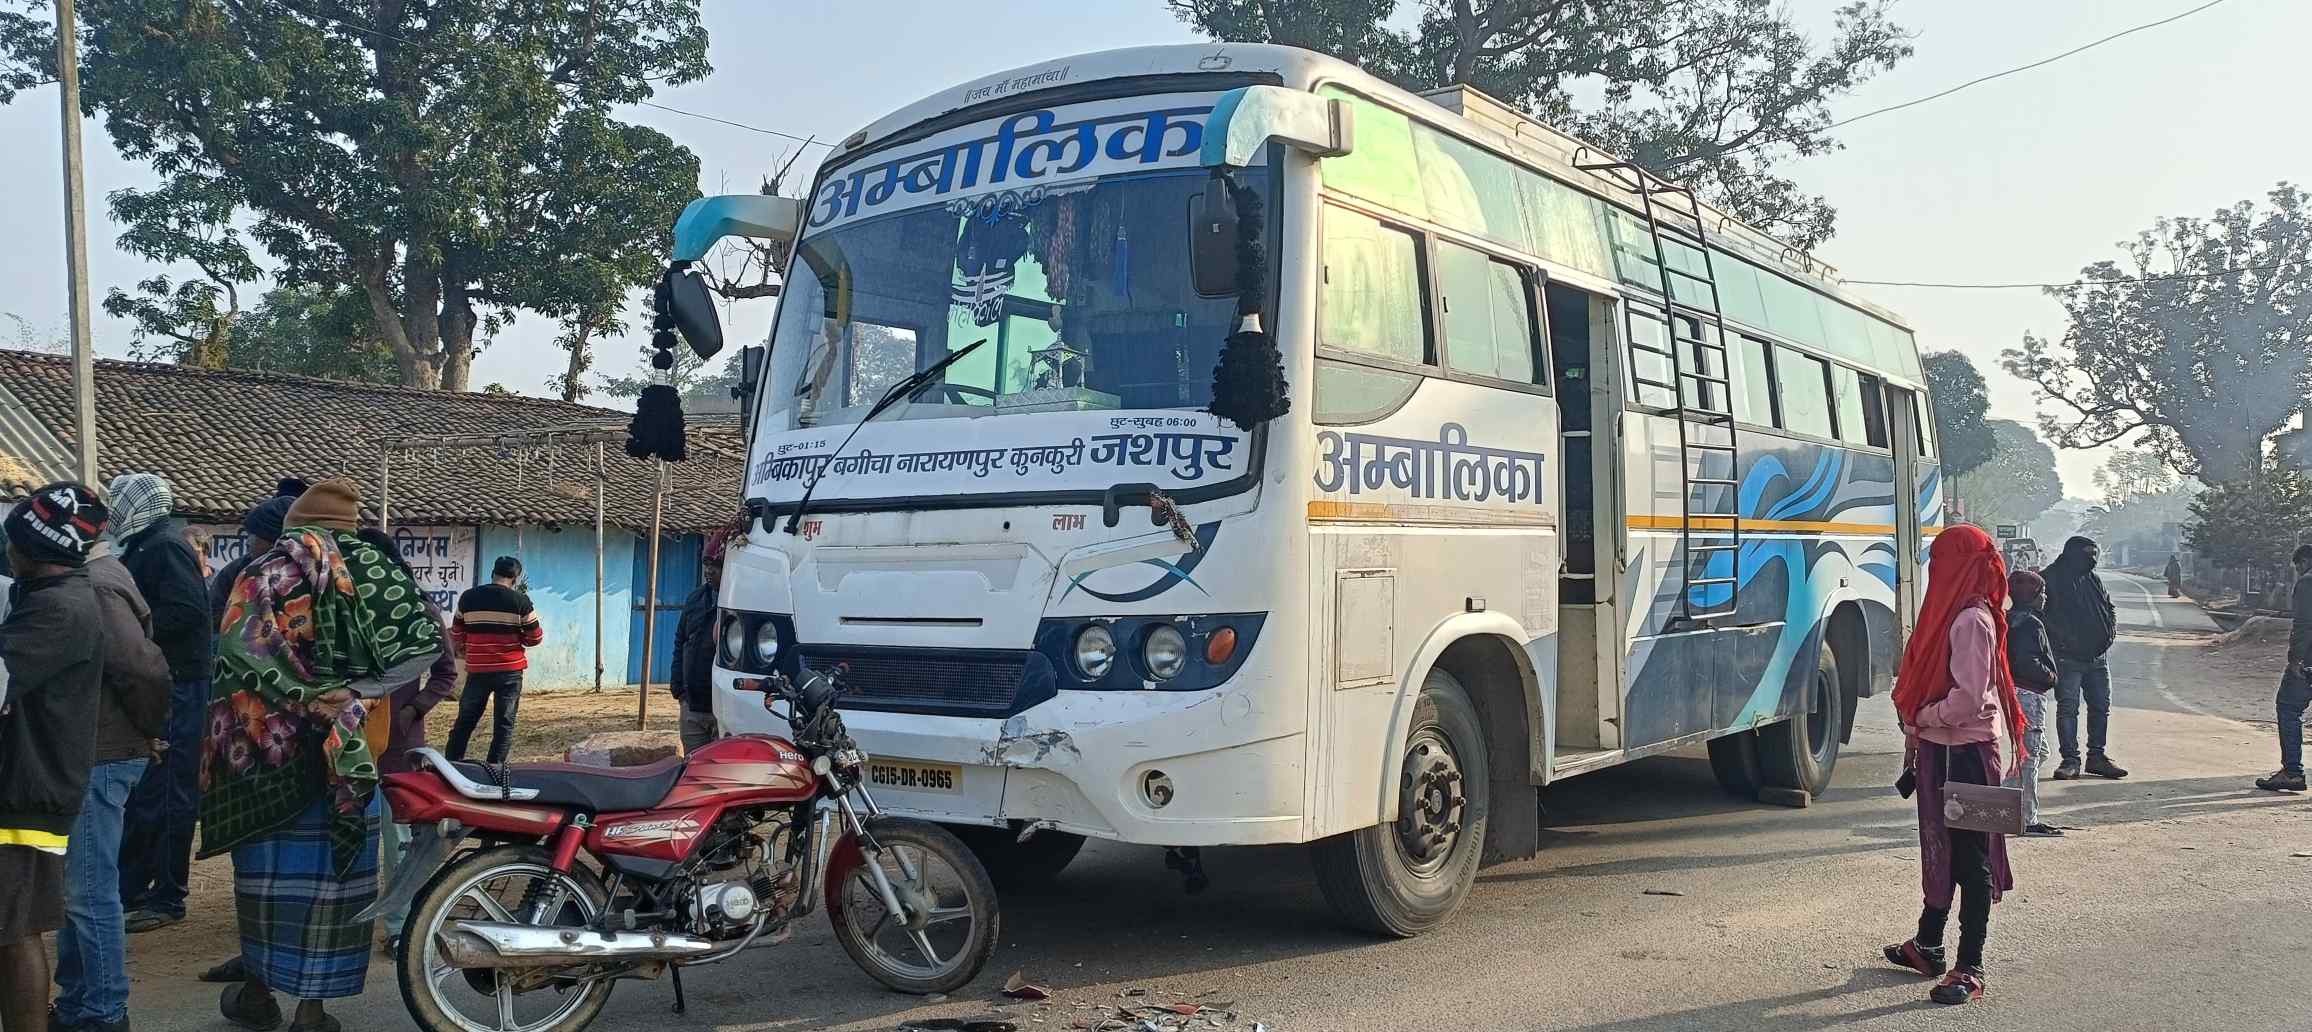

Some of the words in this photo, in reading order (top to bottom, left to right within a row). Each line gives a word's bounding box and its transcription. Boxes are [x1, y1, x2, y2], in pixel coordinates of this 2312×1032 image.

[808, 109, 1215, 227] अम्बालिक
[1166, 417, 1197, 427] 06:00
[834, 449, 894, 476] बगीचा
[896, 447, 1008, 478] नारायणपुर
[1010, 437, 1086, 476] कुनकुरी
[1091, 433, 1239, 481] जशपुर
[1313, 422, 1545, 504] अम्बालिका
[803, 520, 823, 541] शुभ
[1052, 514, 1087, 531] लाभ
[779, 751, 804, 761] Hero
[871, 765, 953, 789] CG15-DR-0965
